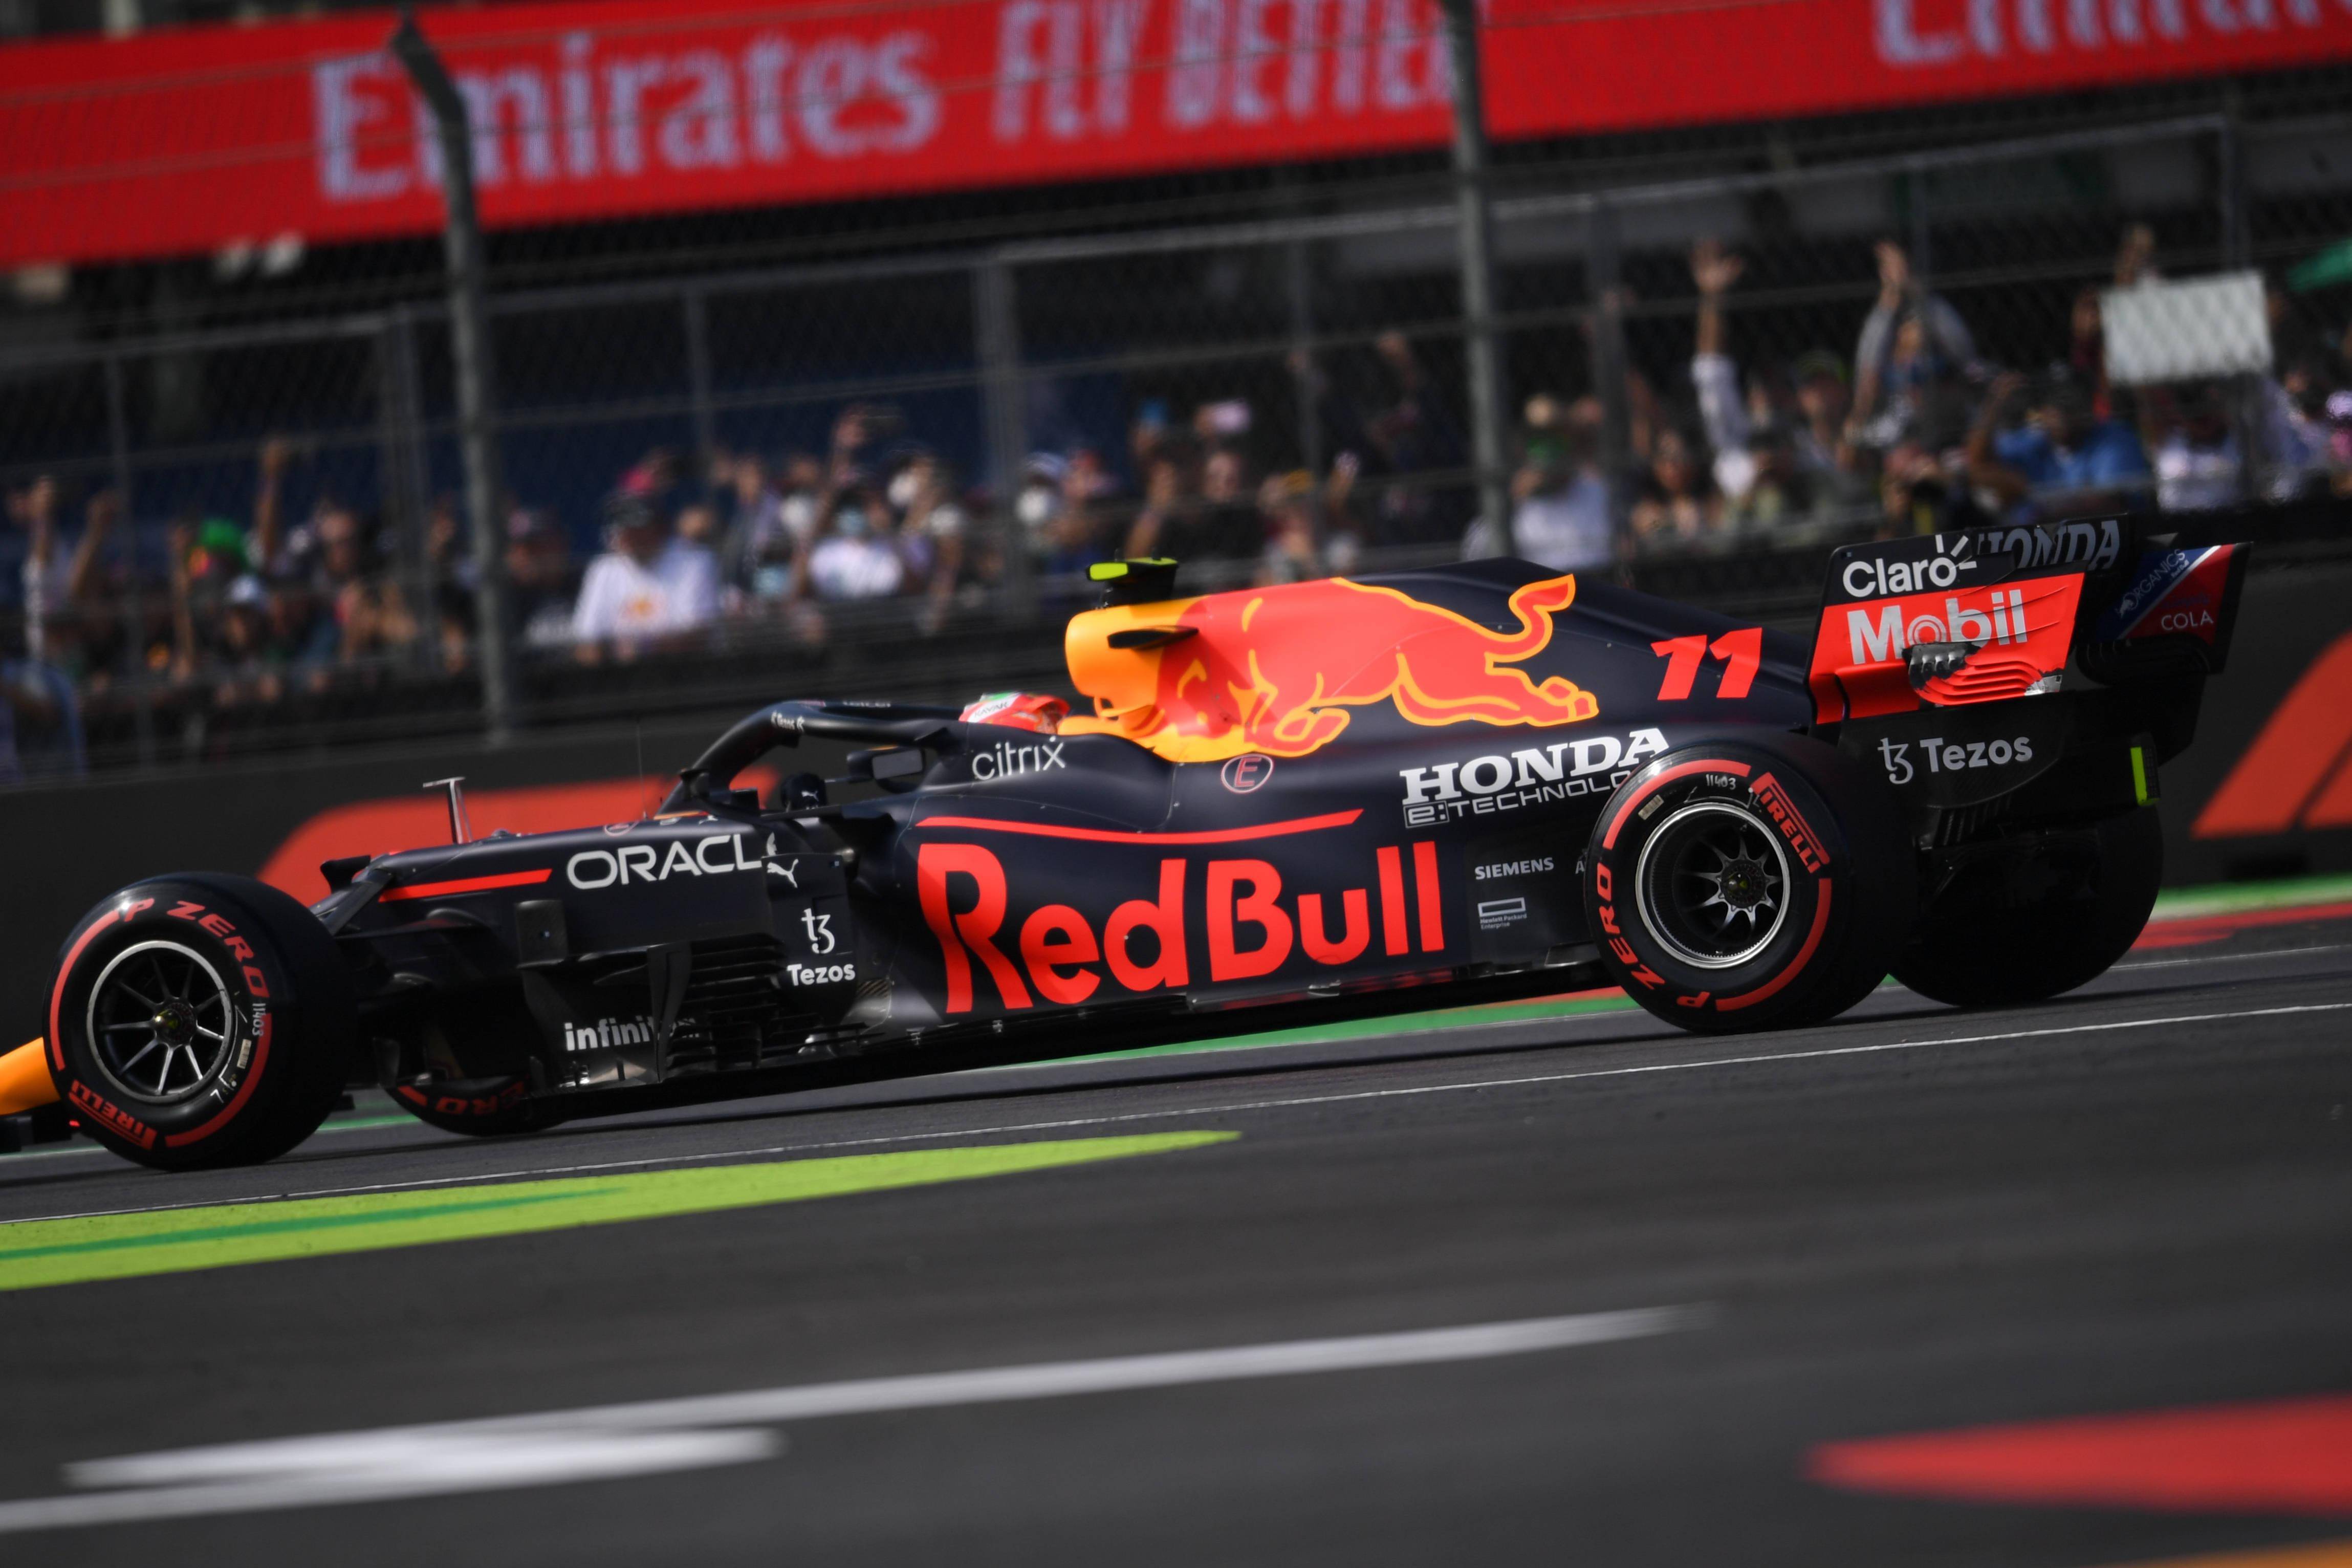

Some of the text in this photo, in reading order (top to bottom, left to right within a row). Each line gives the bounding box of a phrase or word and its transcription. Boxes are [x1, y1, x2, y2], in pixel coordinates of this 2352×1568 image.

[311, 30, 943, 202] Emirates
[991, 0, 1149, 143] FLY
[1843, 556, 1956, 598] Claro
[2123, 549, 2185, 610] ORGANICS
[1847, 589, 2028, 665] Mobil
[2161, 611, 2213, 630] COLA
[1650, 627, 1762, 701] 11
[972, 737, 1066, 780] citrix
[1399, 728, 1670, 805] HONDA
[1920, 736, 2033, 773] Tezos
[1750, 772, 1830, 873] PIRELLI
[567, 834, 761, 889] ORACL
[1474, 857, 1554, 880] SIEMENS
[124, 898, 270, 997] P ZERO
[917, 841, 1444, 1014] Red Bull
[1597, 863, 1710, 1008] P ZERO
[788, 963, 856, 986] Tezos
[564, 1015, 699, 1051] infini
[70, 1079, 157, 1150] PIRELLI
